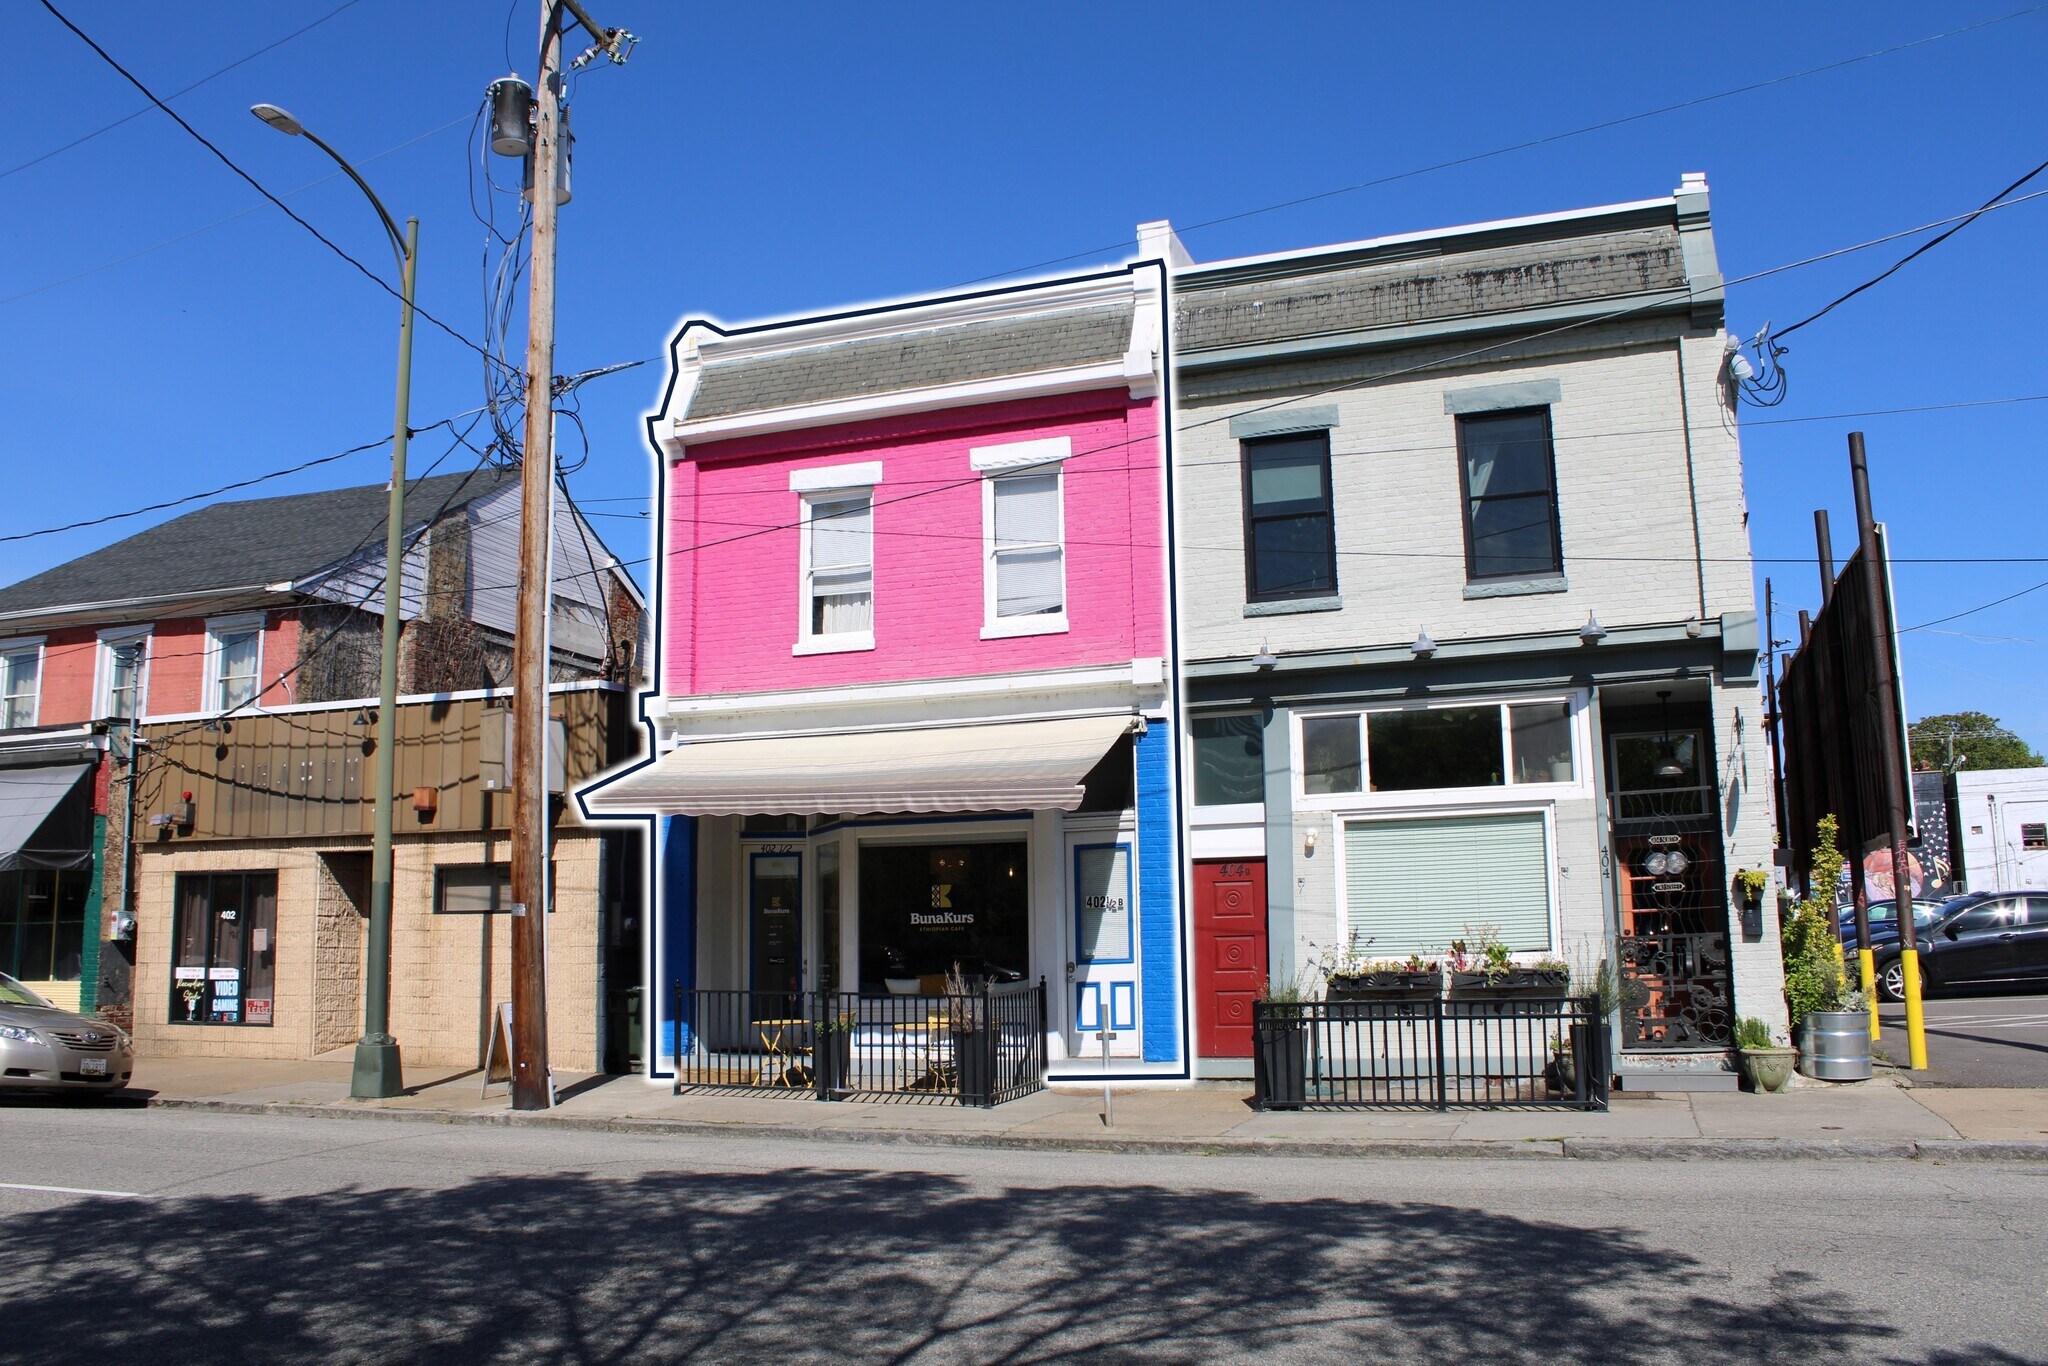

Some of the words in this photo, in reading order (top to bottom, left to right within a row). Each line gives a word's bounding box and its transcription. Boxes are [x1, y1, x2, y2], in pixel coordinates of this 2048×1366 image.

[760, 844, 776, 853] 402
[779, 844, 793, 853] 1/2
[1601, 845, 1610, 879] 404
[221, 910, 236, 919] 402
[910, 912, 975, 925] BunaKurs
[215, 981, 239, 996] VIDEO
[212, 999, 239, 1012] GAMING
[248, 1006, 270, 1014] LEASE
